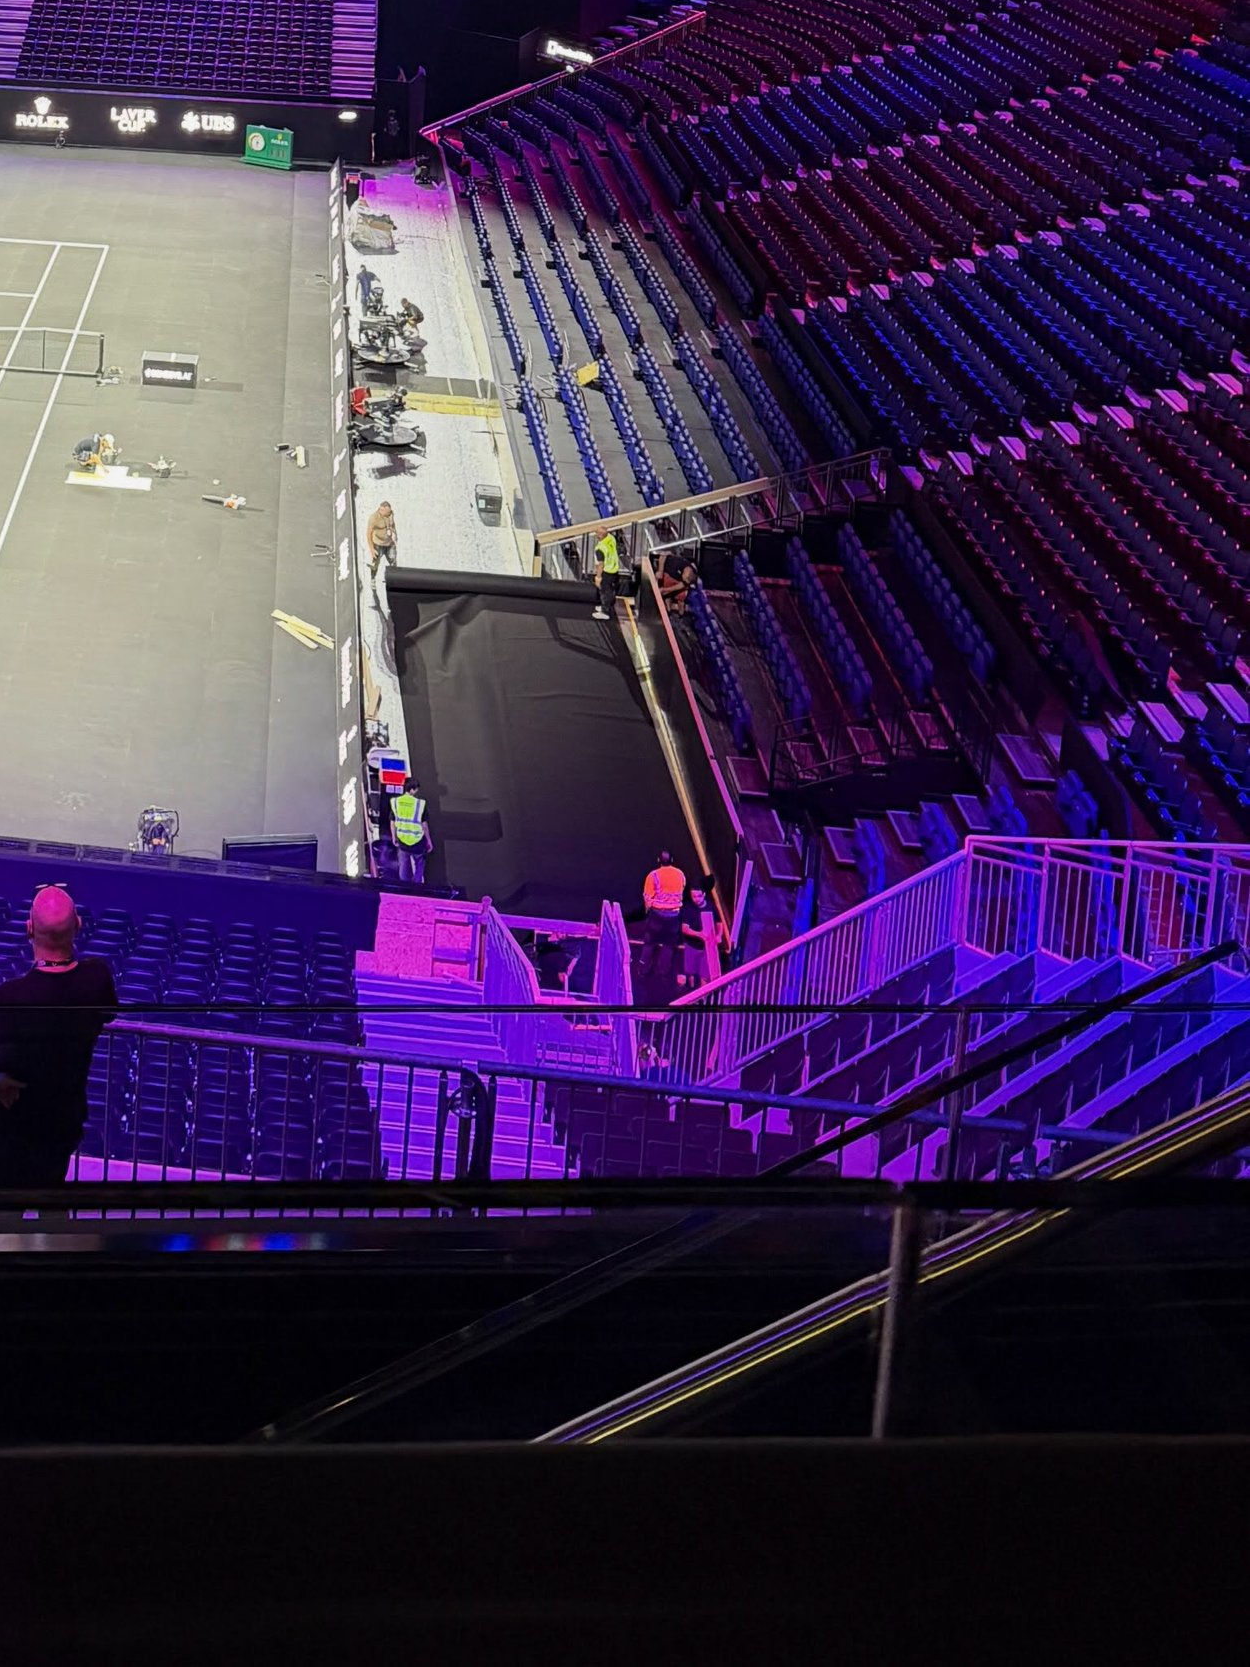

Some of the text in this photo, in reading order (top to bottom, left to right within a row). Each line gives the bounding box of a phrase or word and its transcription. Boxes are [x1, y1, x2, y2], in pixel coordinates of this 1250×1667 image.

[15, 113, 69, 130] ROLEX
[111, 107, 157, 124] LAVER
[201, 115, 236, 131] UBS
